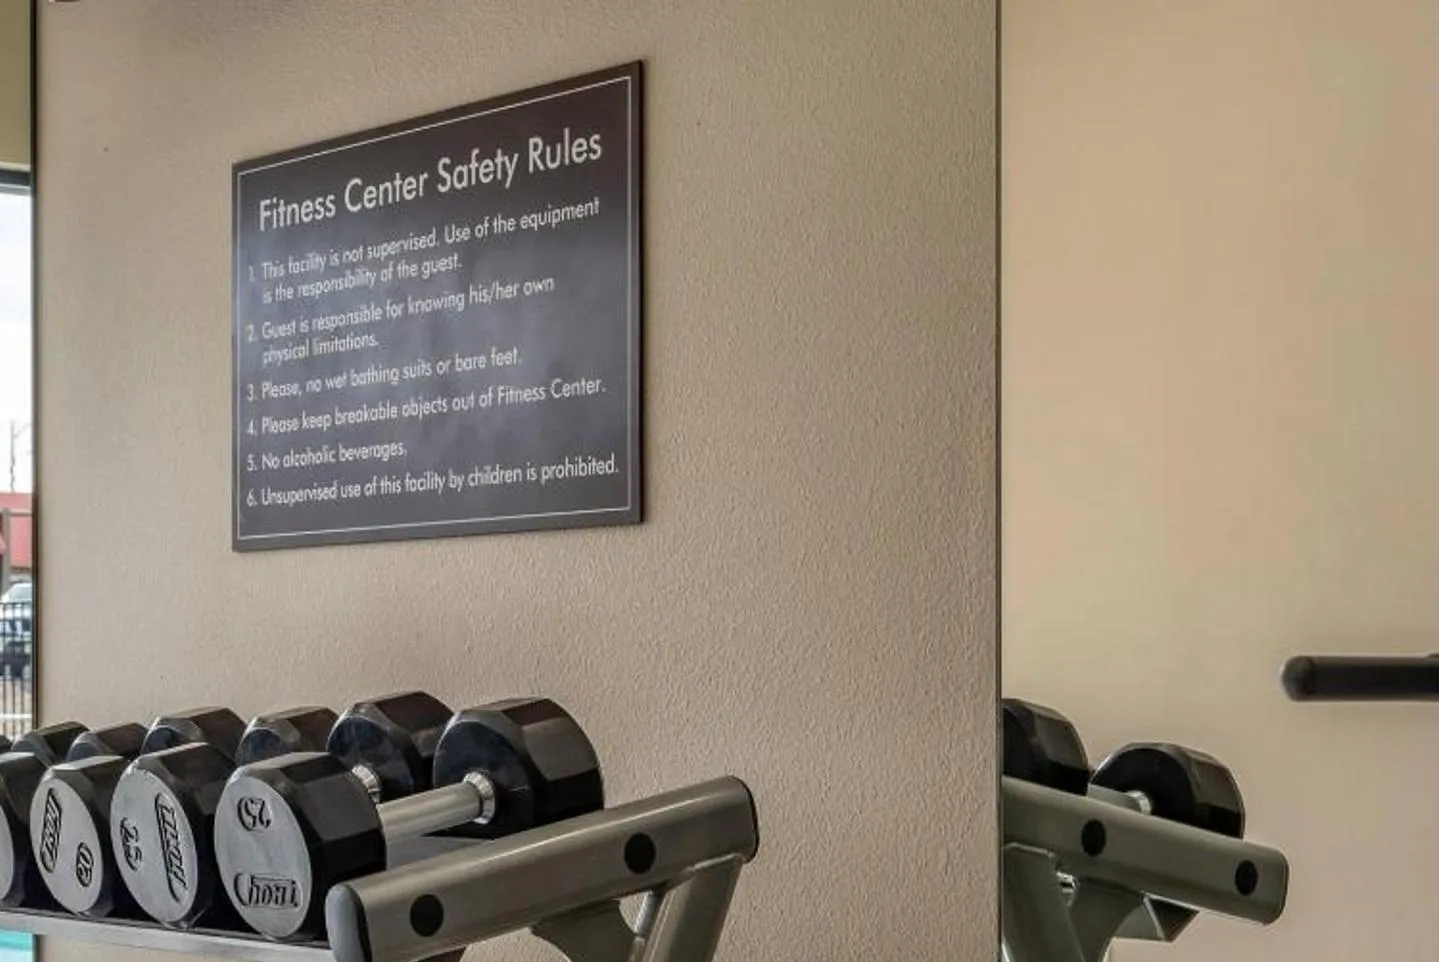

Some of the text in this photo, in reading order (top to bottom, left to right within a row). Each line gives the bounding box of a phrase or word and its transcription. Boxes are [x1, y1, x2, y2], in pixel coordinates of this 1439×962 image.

[260, 127, 603, 231] Fitness Center Safety Rules
[262, 260, 285, 279] This
[288, 252, 327, 274] facility
[329, 249, 340, 266] is
[342, 245, 364, 262] not
[366, 226, 440, 260] supervised.
[444, 224, 471, 244] Use
[474, 216, 490, 239] of
[493, 213, 516, 234] the
[519, 196, 601, 230] equipment
[275, 283, 294, 302] the
[297, 267, 377, 298] responsibility
[380, 261, 395, 282] of
[397, 256, 418, 276] the
[420, 252, 463, 280] guest.
[261, 319, 297, 340] Guest
[299, 315, 310, 333] is
[312, 302, 383, 330] responsible
[386, 298, 405, 319] for
[407, 290, 465, 315] knowing
[469, 281, 520, 306] his/her
[523, 277, 555, 296] own
[261, 380, 303, 400] Please,
[305, 377, 322, 393] no
[324, 373, 348, 390] wet
[350, 364, 400, 388] bathing
[401, 359, 432, 378] suits
[436, 359, 451, 376] or
[455, 352, 487, 372] bare
[262, 340, 310, 367] physical
[261, 415, 299, 434] Please
[301, 410, 332, 432] keep
[334, 403, 398, 426] breakable
[401, 396, 448, 421] objects
[451, 391, 475, 411] out
[478, 386, 495, 407] of
[497, 383, 546, 405] Fitness
[550, 378, 607, 399] Center.
[261, 453, 280, 471] No
[282, 444, 338, 467] alcoholic
[339, 440, 408, 462] beverages.
[261, 480, 338, 507] Unsupervised
[339, 482, 361, 499] use
[363, 475, 378, 495] of
[380, 474, 402, 494] this
[404, 470, 446, 495] facility
[447, 467, 466, 492] by
[467, 462, 523, 488] children
[526, 461, 538, 482] is
[541, 451, 620, 486] prohibited.
[237, 797, 273, 832] 25
